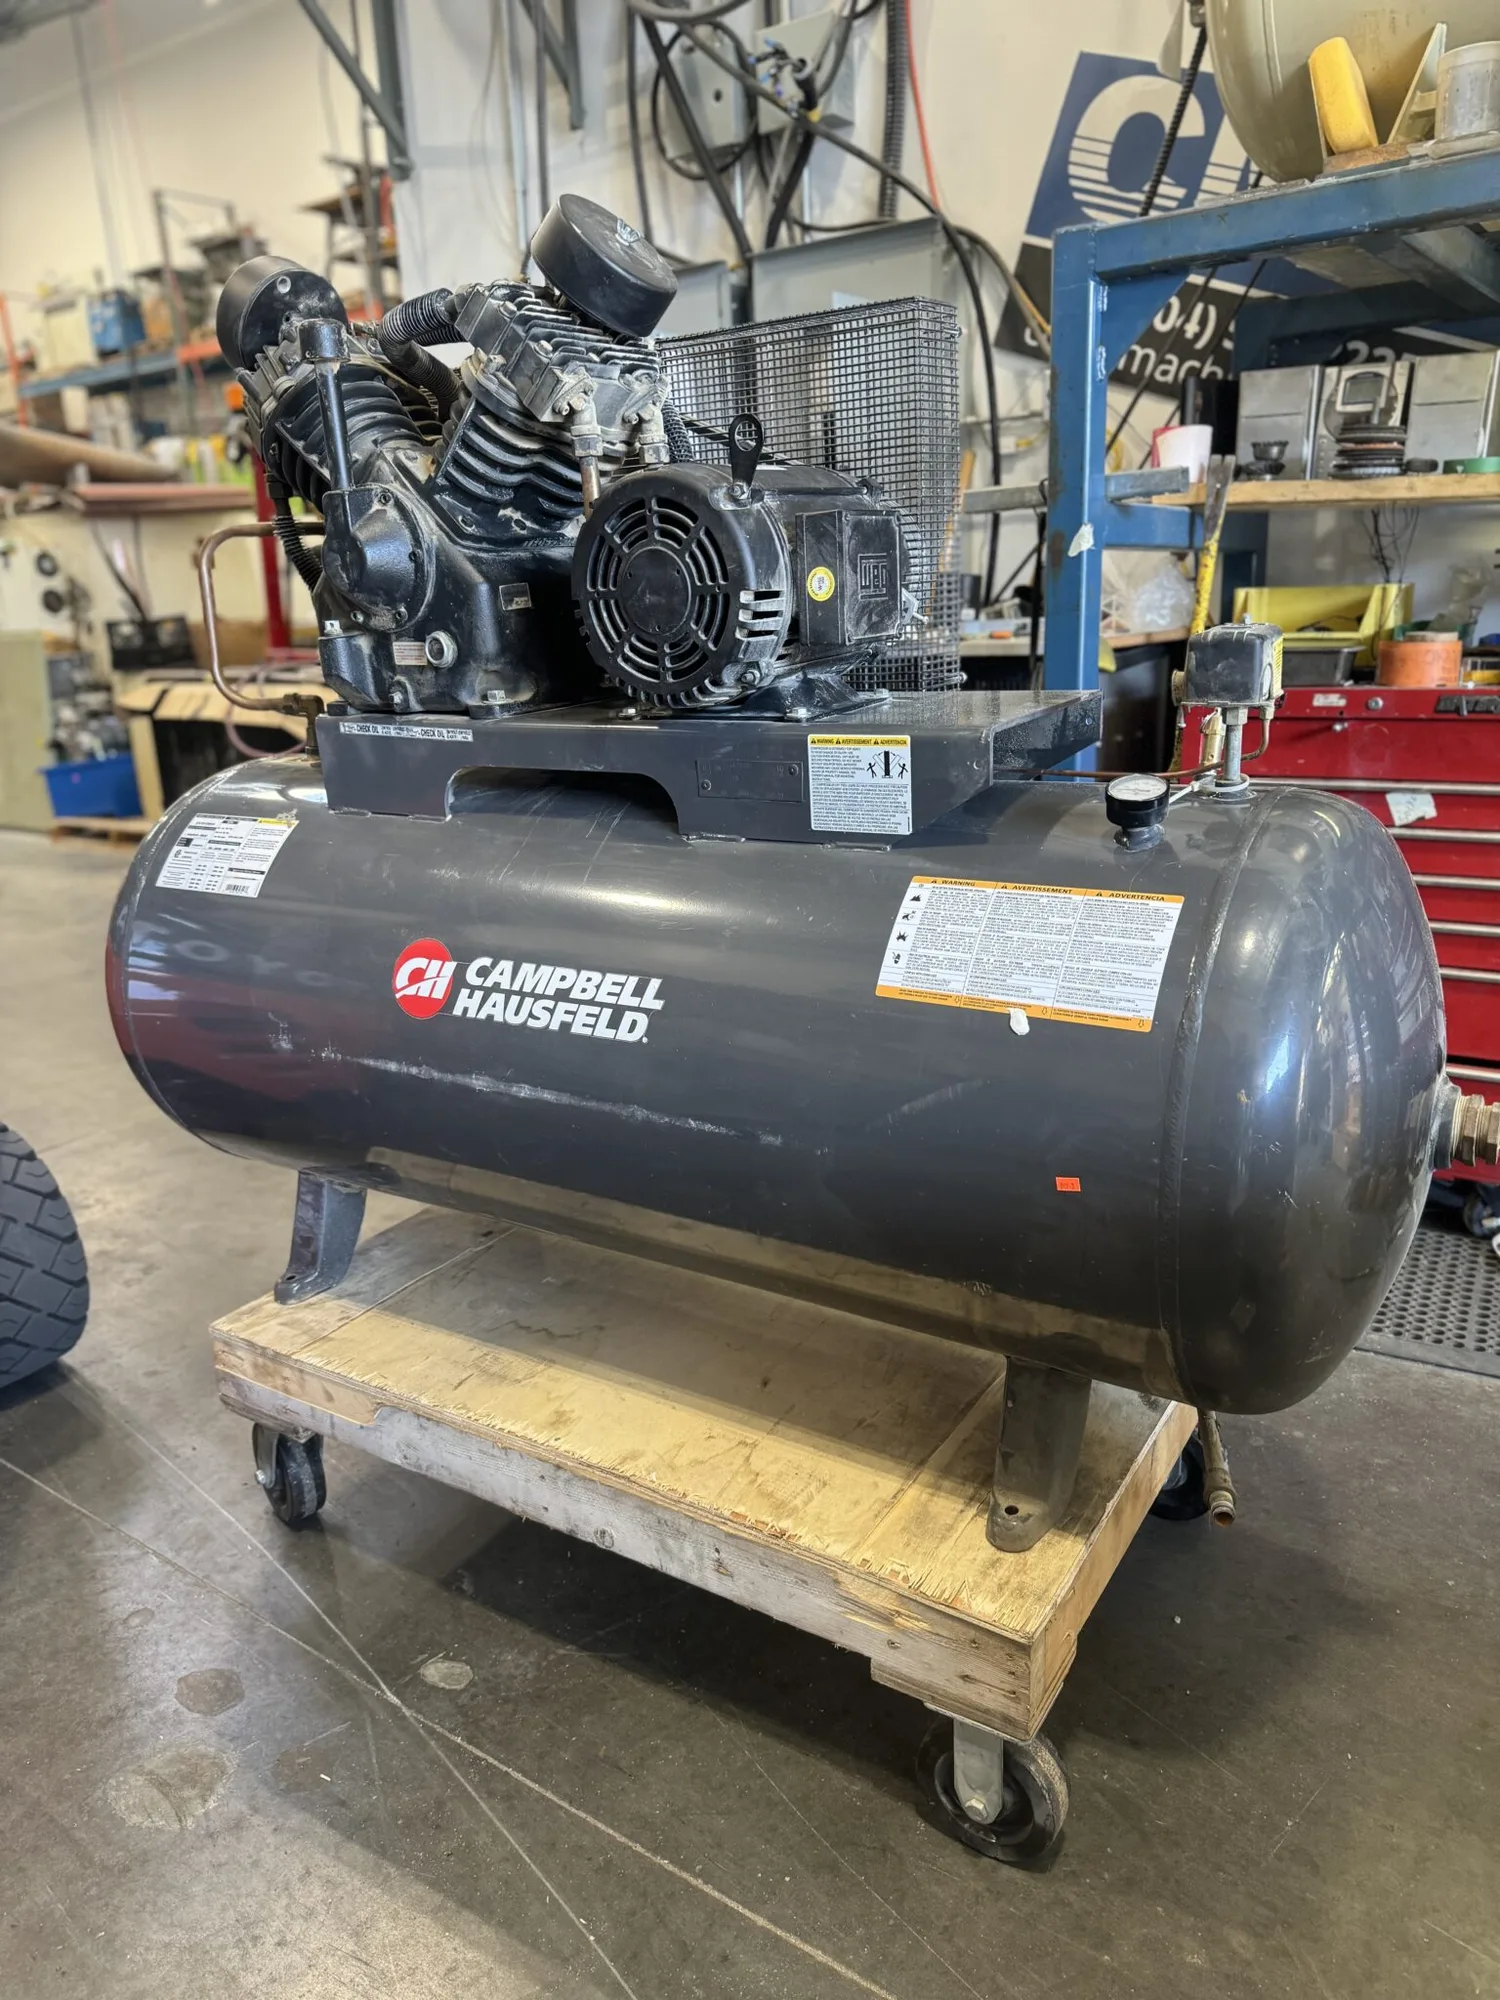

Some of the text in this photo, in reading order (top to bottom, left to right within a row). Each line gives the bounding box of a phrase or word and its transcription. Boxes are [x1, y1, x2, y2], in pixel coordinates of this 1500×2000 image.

[1118, 343, 1233, 384] mach
[941, 879, 1165, 902] WARNING AVERTISSEMENT ADVERTENCIA
[465, 956, 666, 1011] CAMPBELL
